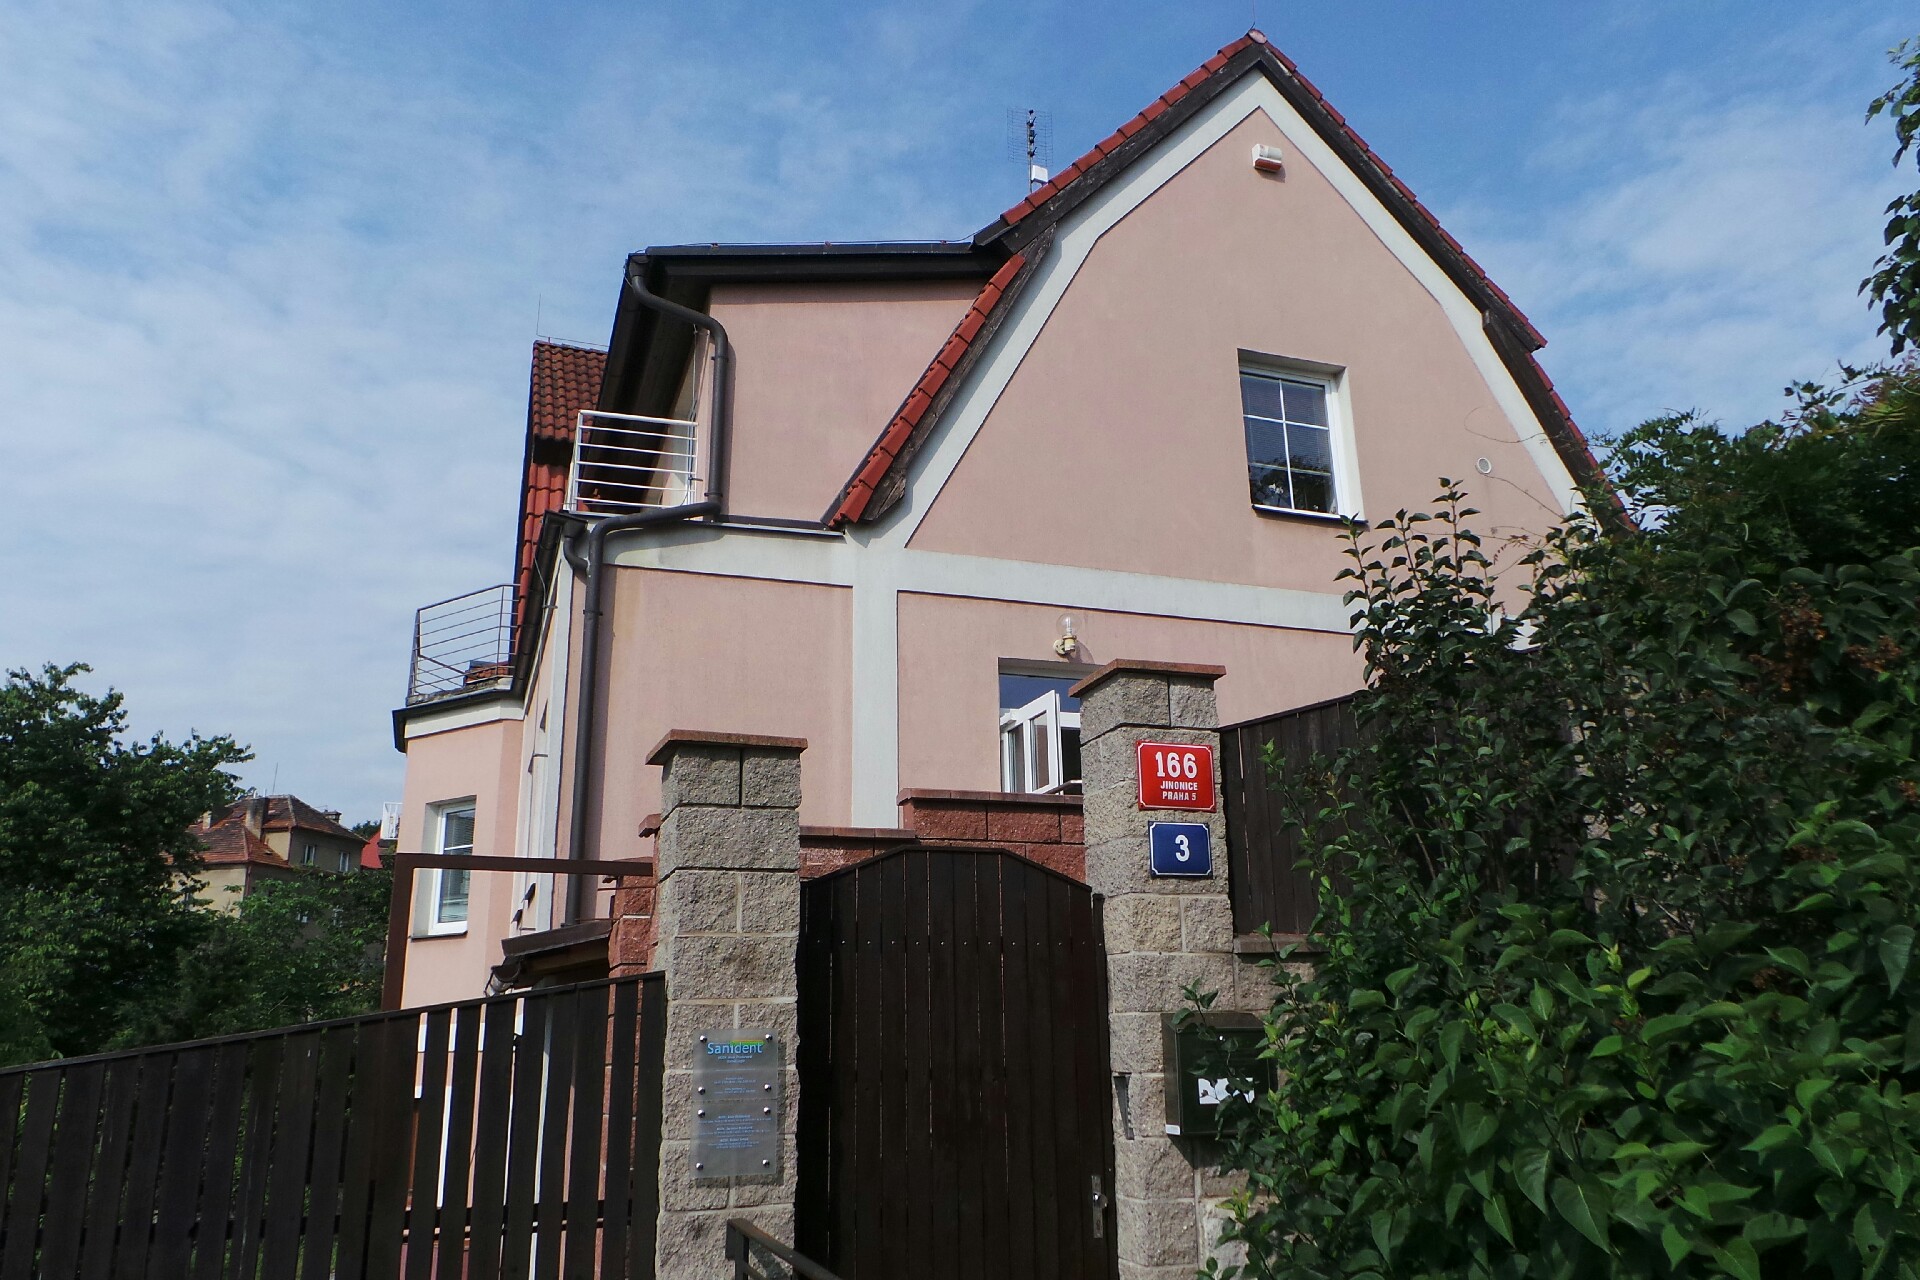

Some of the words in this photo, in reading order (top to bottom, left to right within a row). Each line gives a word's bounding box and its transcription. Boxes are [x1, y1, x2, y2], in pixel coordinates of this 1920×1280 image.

[1155, 751, 1198, 779] 166
[1160, 780, 1198, 791] JINONICE
[1162, 791, 1189, 801] PRAHA
[1191, 792, 1197, 801] 5
[1175, 834, 1190, 862] 3
[707, 1042, 763, 1054] Sanident
